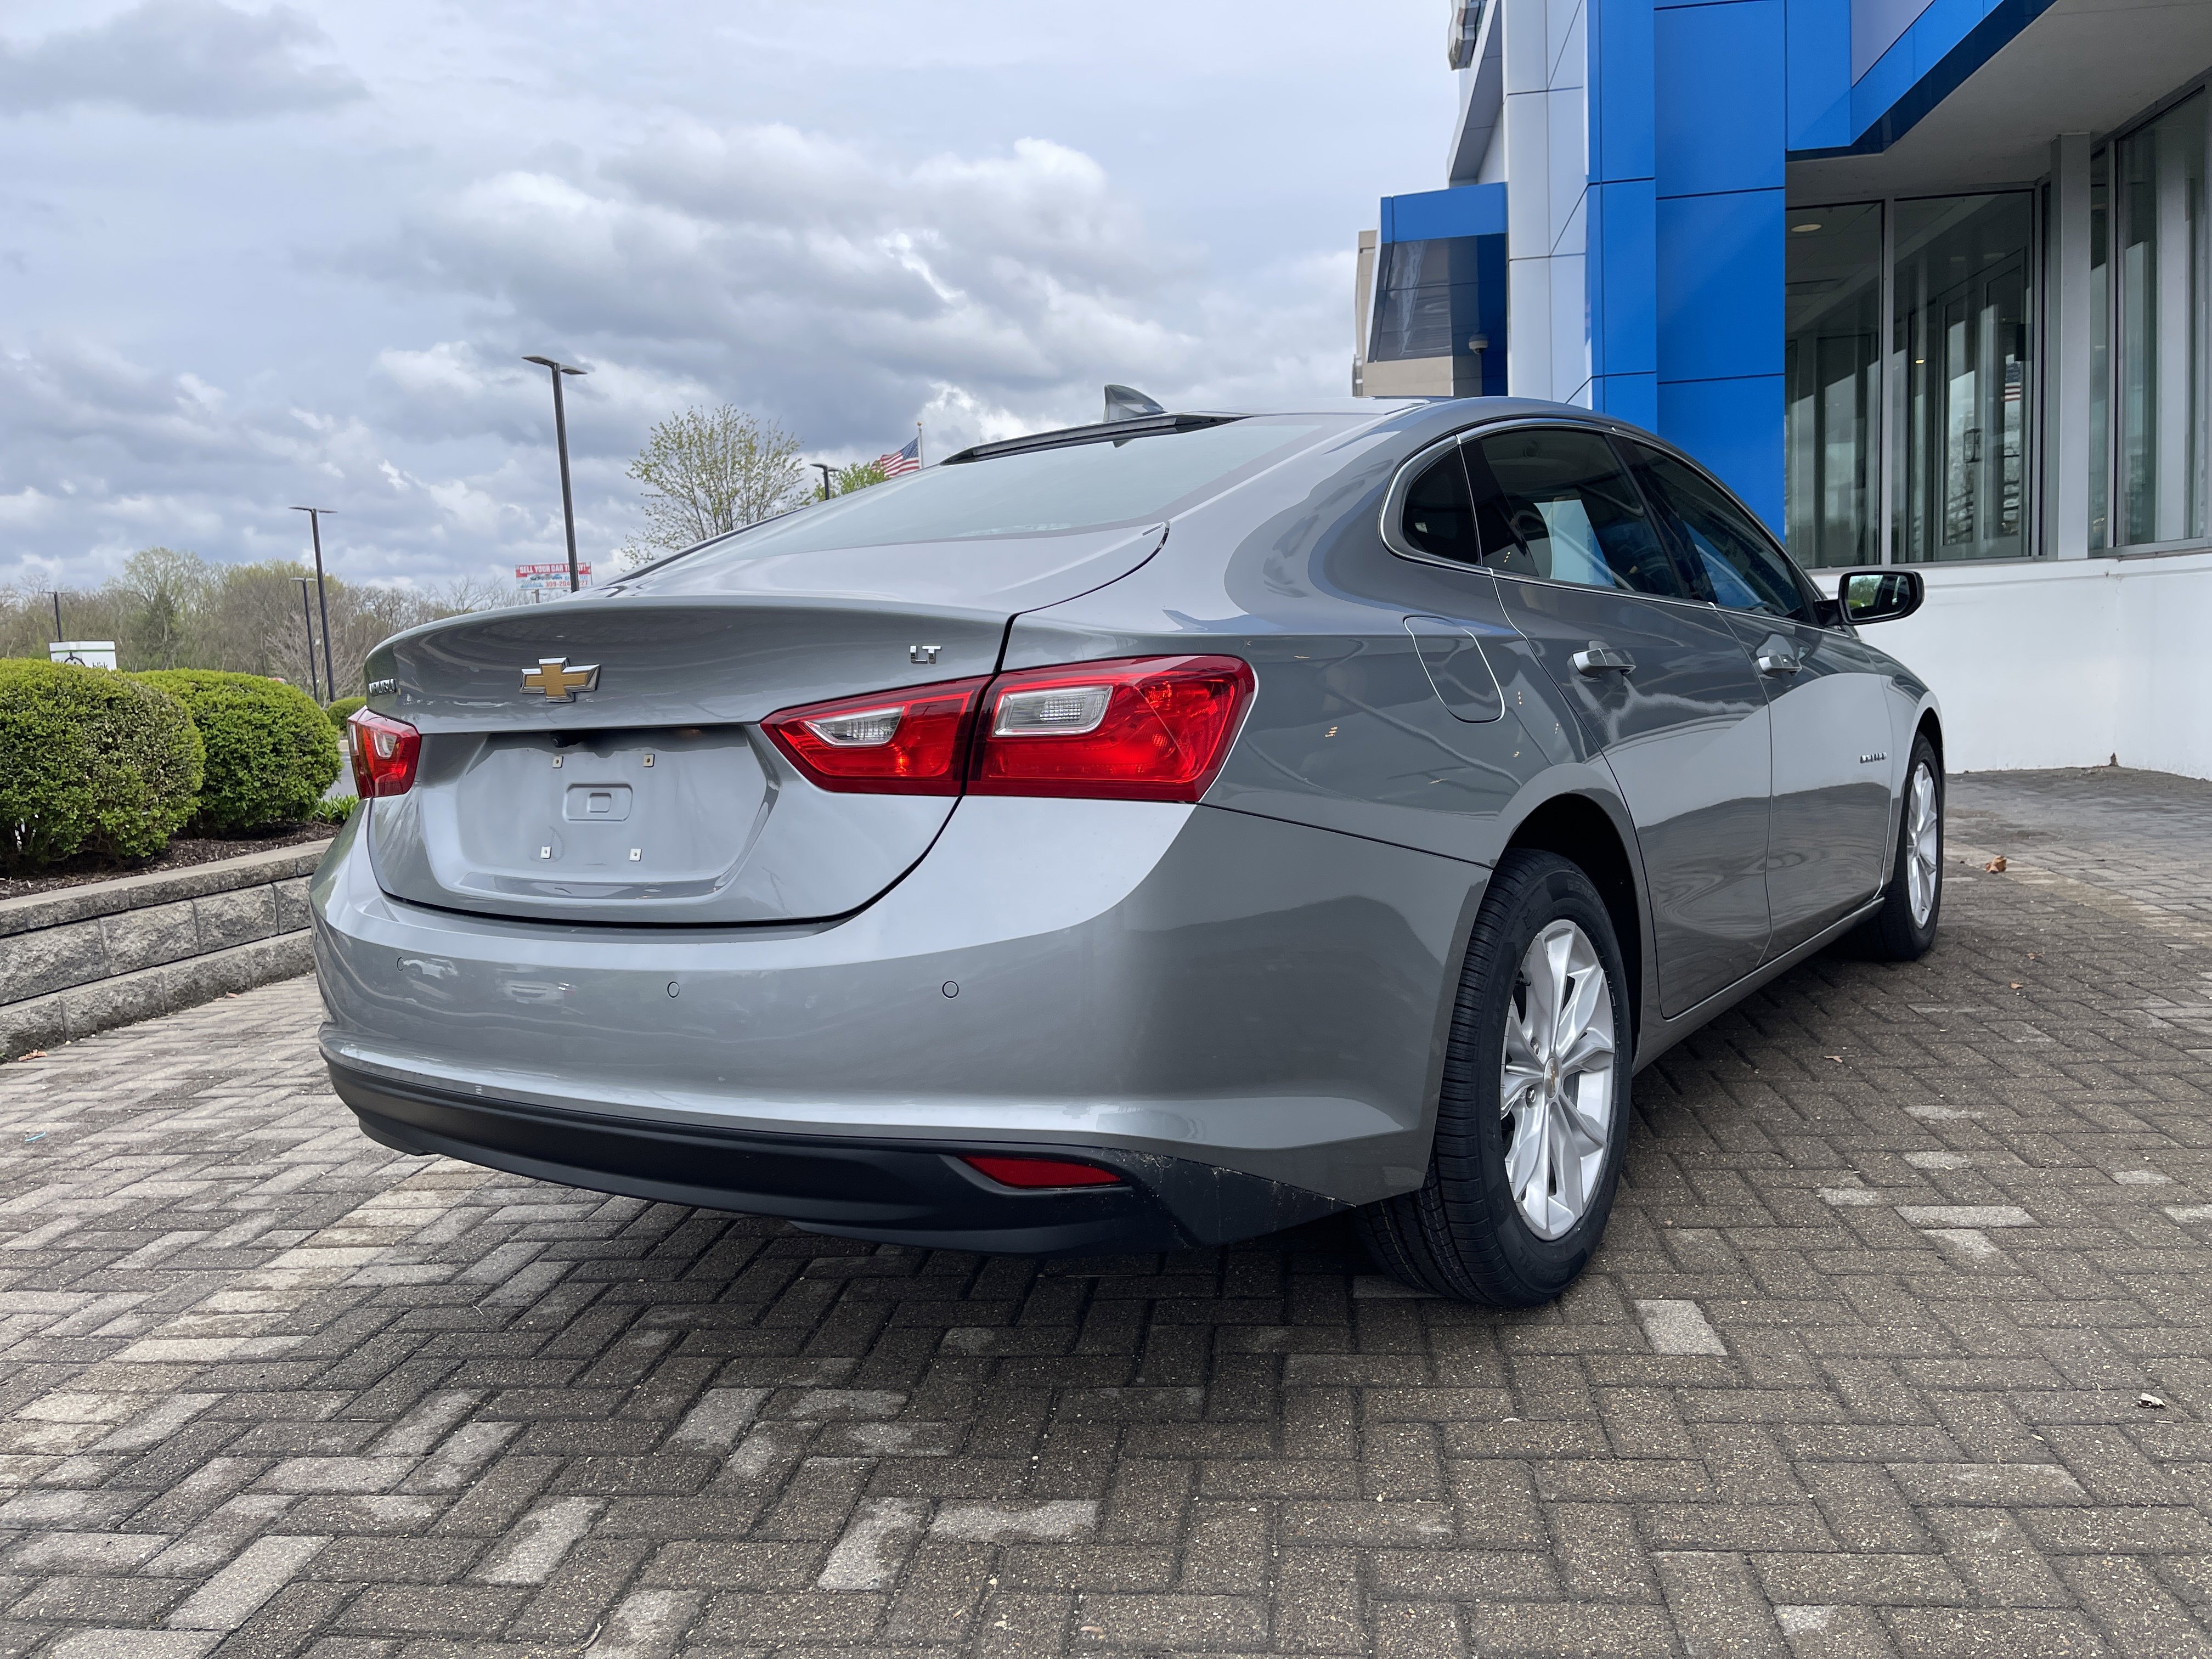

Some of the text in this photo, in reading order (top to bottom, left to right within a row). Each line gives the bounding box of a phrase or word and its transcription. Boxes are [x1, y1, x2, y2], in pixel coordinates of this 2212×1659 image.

[520, 566, 533, 574] SELL
[564, 563, 586, 572] TAY!
[910, 645, 942, 664] LT
